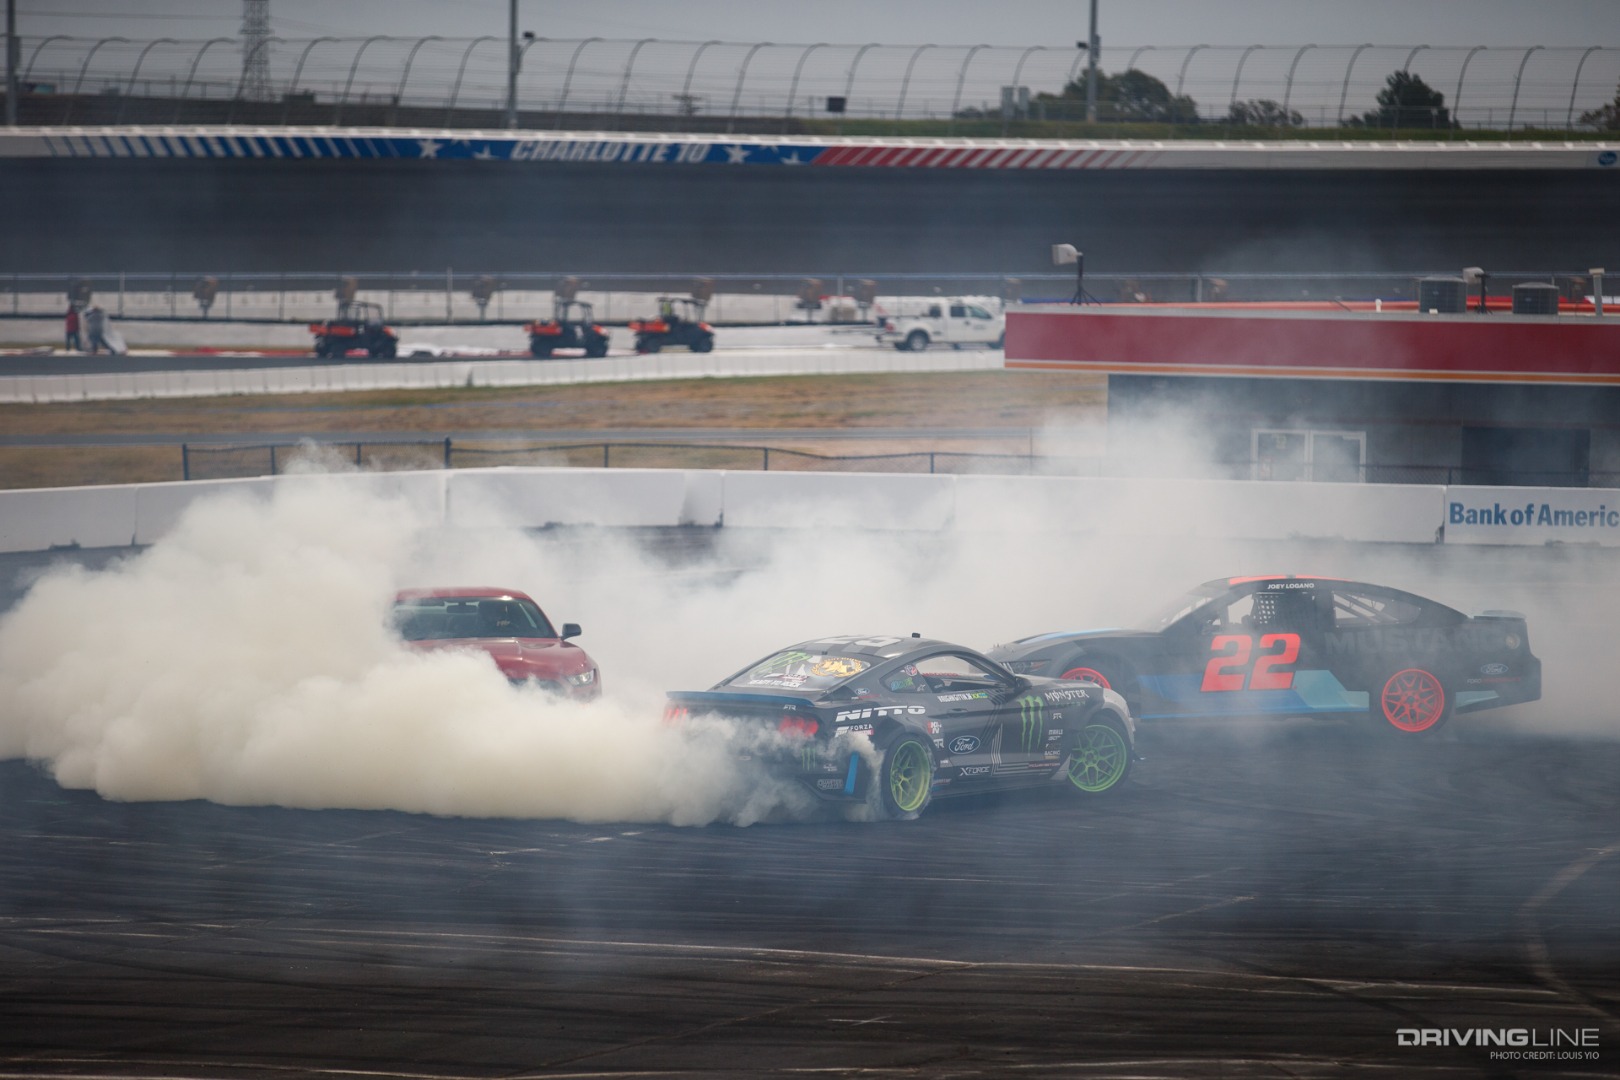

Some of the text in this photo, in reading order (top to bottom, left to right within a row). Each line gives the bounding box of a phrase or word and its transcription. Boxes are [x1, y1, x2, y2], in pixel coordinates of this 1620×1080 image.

[510, 140, 672, 162] CHARLOTTE
[1450, 502, 1507, 526] Bank
[1511, 503, 1534, 526] of
[1200, 633, 1301, 691] 22
[835, 705, 926, 722] NITTO
[850, 723, 873, 731] FORZA
[953, 737, 976, 752] Ford
